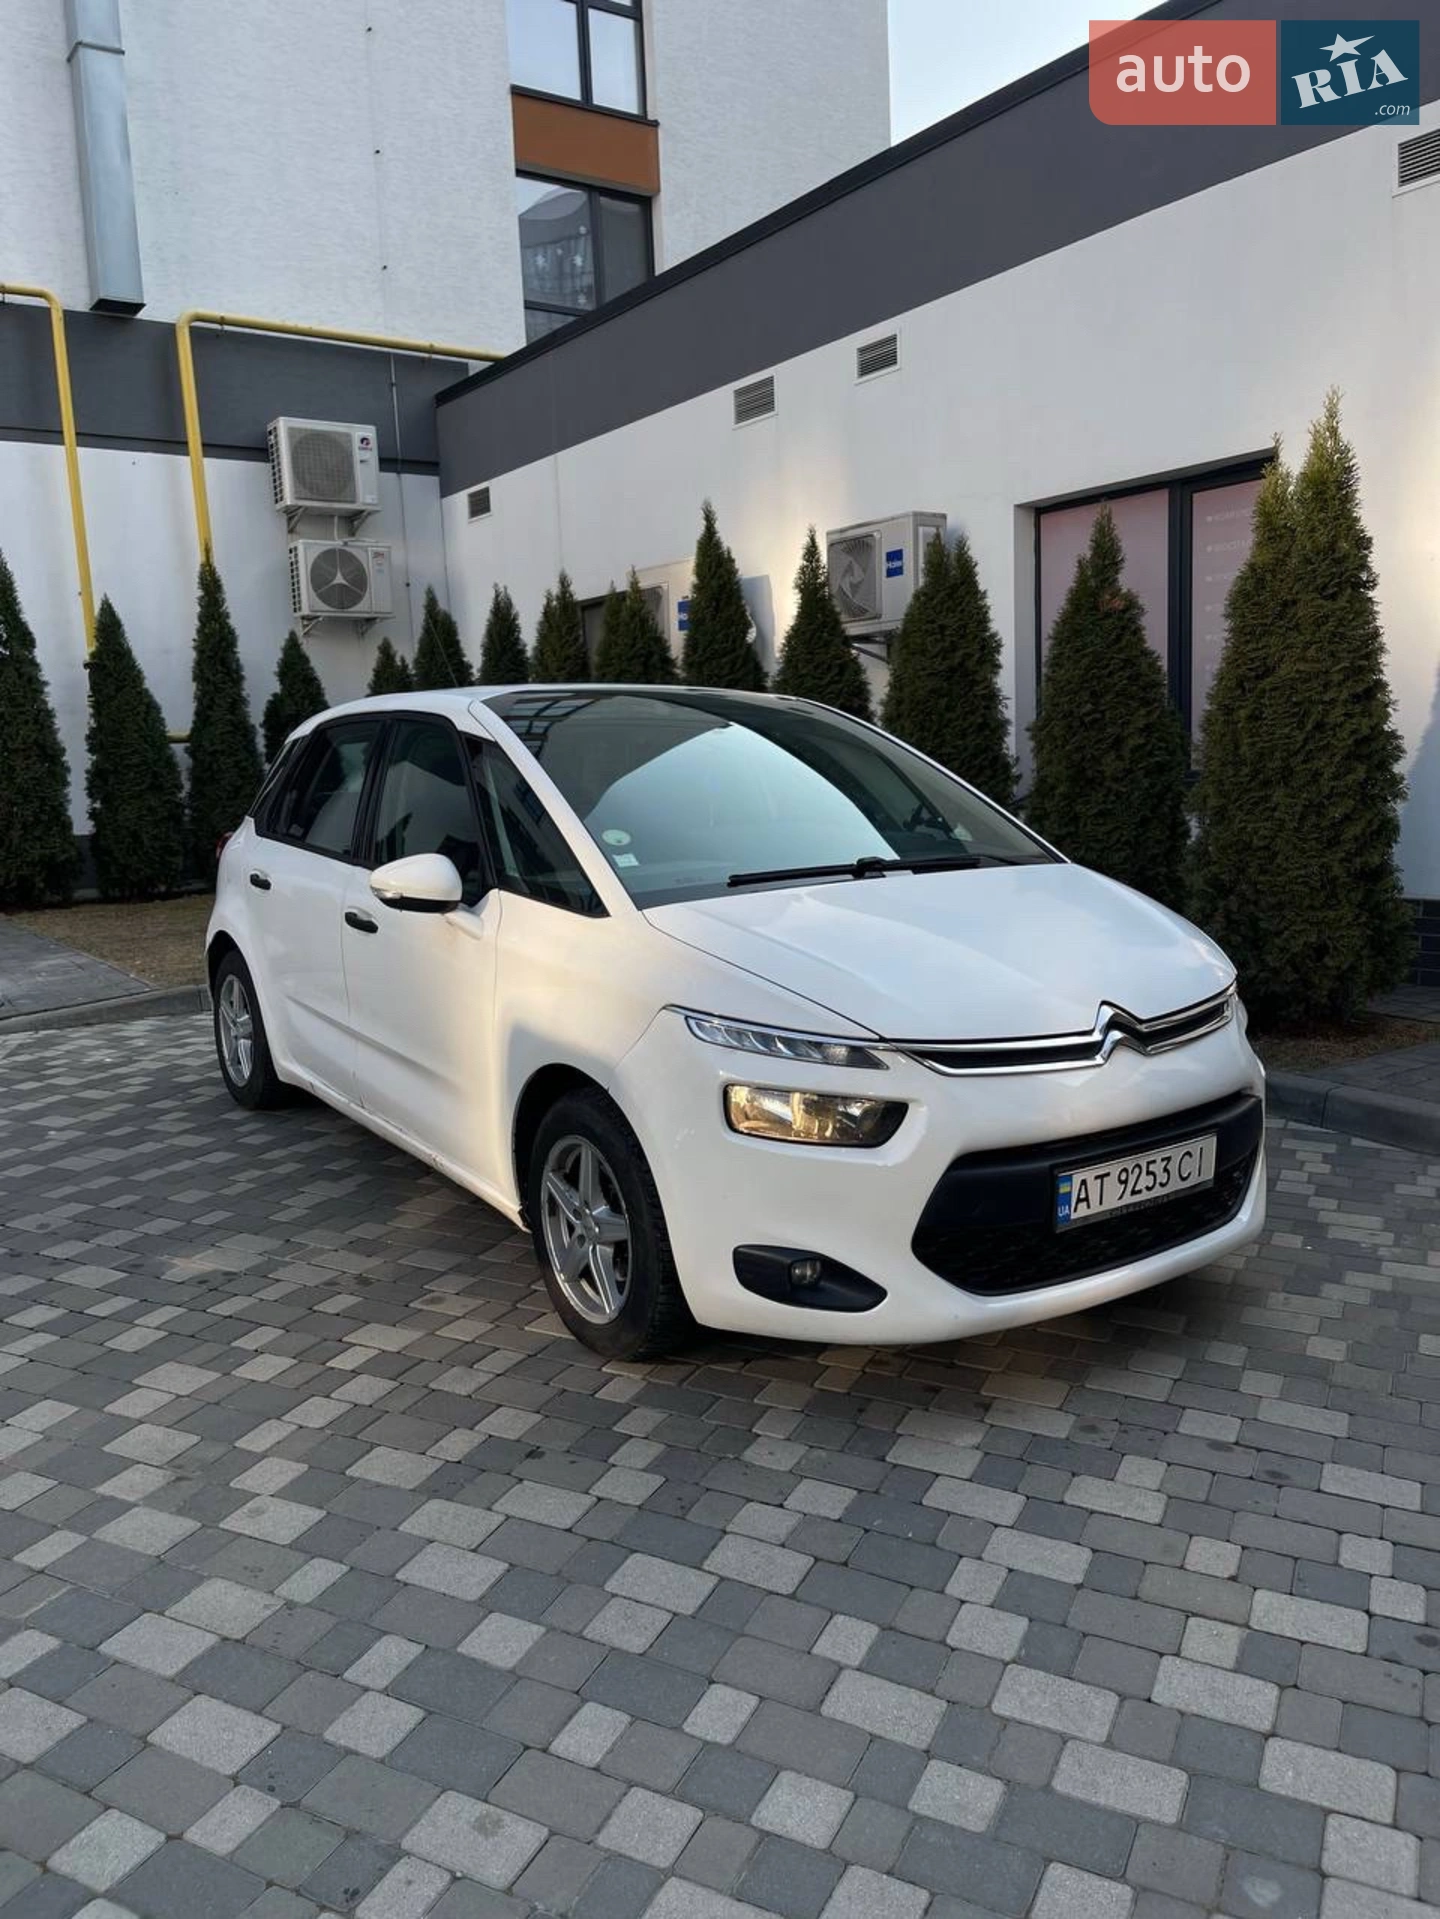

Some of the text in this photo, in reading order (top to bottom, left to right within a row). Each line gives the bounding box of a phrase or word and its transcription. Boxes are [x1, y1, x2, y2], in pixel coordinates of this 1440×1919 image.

[1073, 1172, 1111, 1213] AT
[1117, 1155, 1173, 1201] 9253
[1178, 1147, 1204, 1181] CI
[1058, 1205, 1070, 1217] UA
